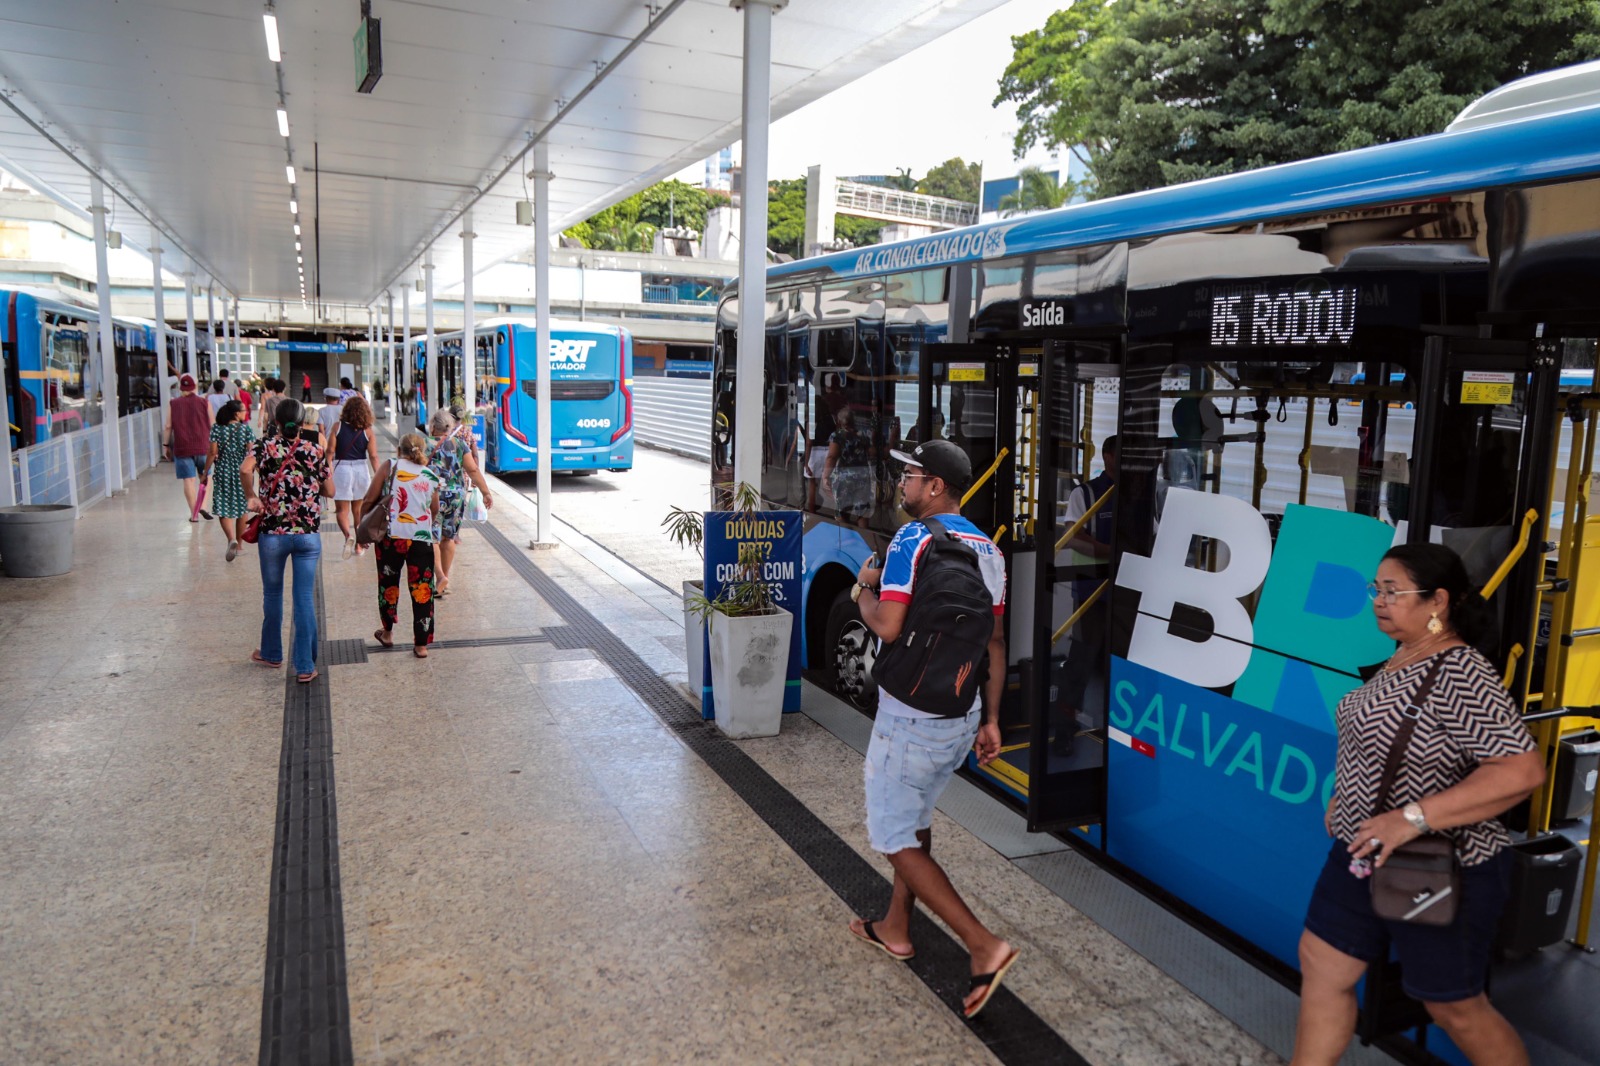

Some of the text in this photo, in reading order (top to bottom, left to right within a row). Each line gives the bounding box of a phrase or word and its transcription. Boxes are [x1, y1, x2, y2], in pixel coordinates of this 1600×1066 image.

[854, 231, 984, 273] AR CONDICIONADO
[1023, 301, 1064, 326] Saída
[1251, 288, 1357, 344] RODOV
[576, 418, 611, 429] 40049
[725, 517, 785, 540] DÚVIDAS
[764, 561, 794, 581] COM
